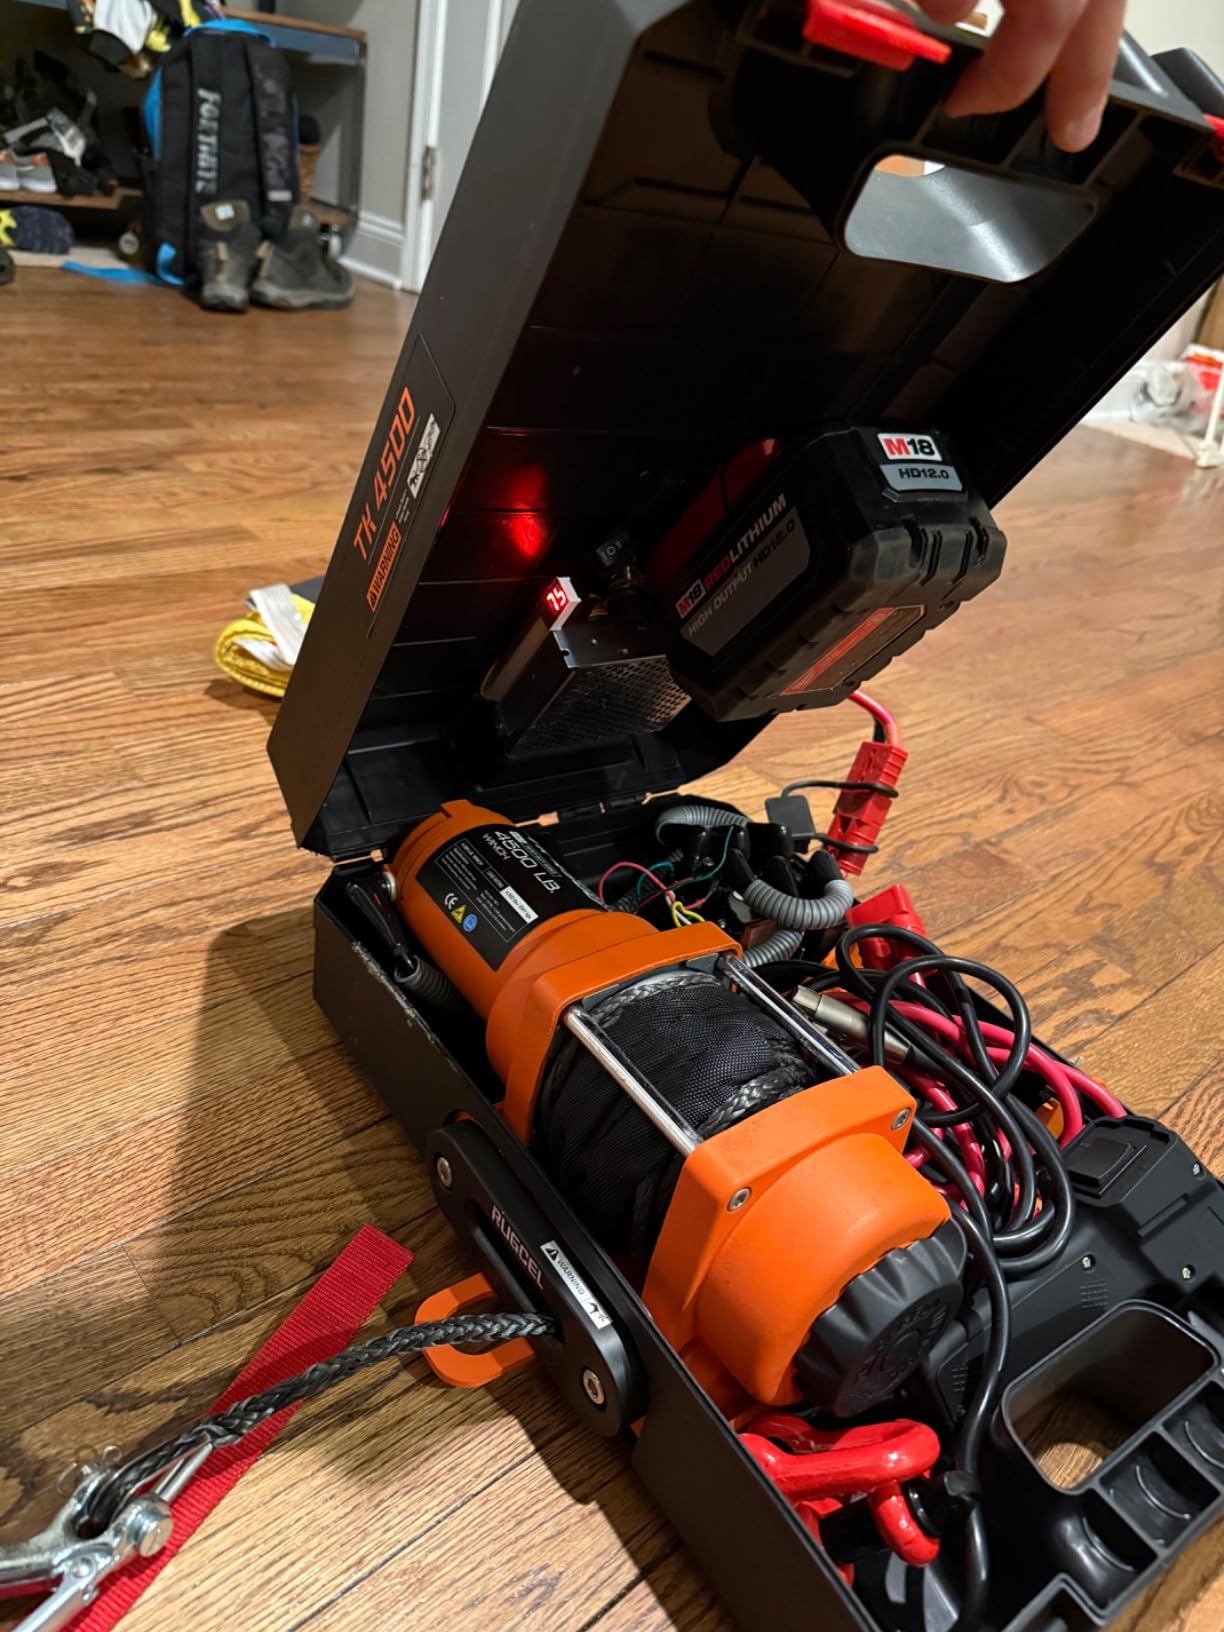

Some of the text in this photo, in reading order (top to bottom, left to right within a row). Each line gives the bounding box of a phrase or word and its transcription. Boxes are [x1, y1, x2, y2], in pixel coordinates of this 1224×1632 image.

[883, 437, 936, 456] M18
[353, 502, 377, 560] TK
[374, 386, 415, 511] 4500
[898, 467, 950, 480] HD12.0
[372, 527, 400, 591] WARNING
[688, 518, 796, 637] HIGH OUTPUT HD12.0
[546, 587, 567, 611] 75
[676, 583, 704, 615] M18
[482, 832, 512, 861] WINCH
[494, 830, 539, 869] 4500
[533, 871, 561, 894] LB.
[444, 892, 459, 910] CE
[491, 1204, 544, 1291] RUGCEL
[556, 1258, 586, 1295] WARNING
